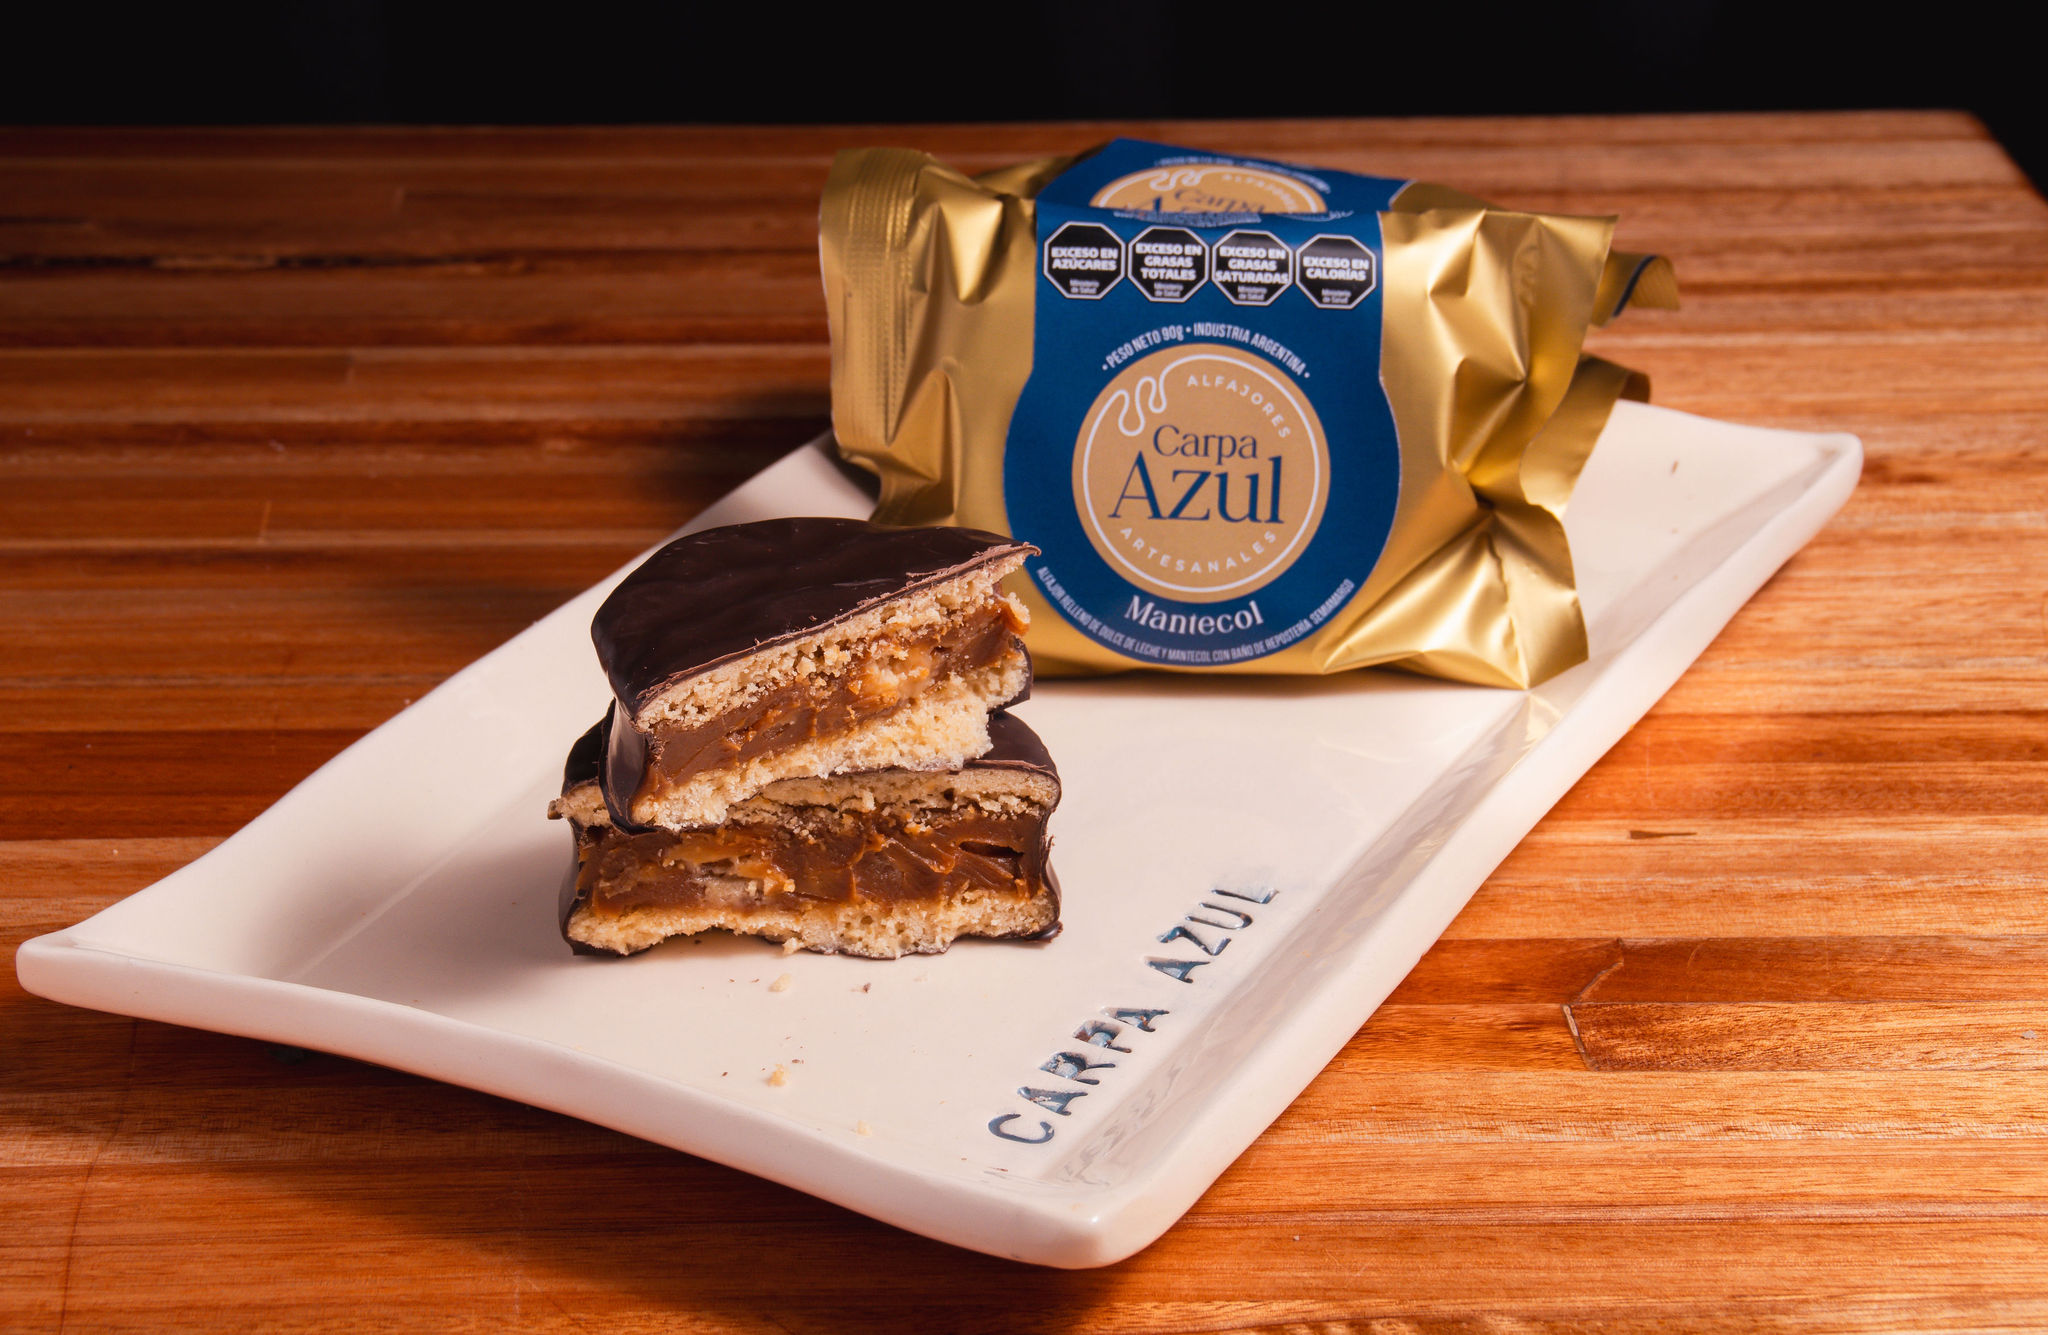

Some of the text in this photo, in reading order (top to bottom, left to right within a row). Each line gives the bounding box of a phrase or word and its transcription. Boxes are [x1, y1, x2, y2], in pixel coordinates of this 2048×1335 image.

[1051, 247, 1118, 259] EXCESO EN
[1135, 243, 1202, 256] EXCESO EN
[1219, 247, 1286, 259] EXCESO EN
[1052, 257, 1117, 270] AZÚCARES
[1144, 256, 1193, 267] GRASAS
[1228, 259, 1277, 271] GRASAS
[1303, 256, 1369, 270] EXCESO EN
[1140, 268, 1196, 280] TOTALES
[1215, 271, 1289, 284] SATURADAS
[1305, 268, 1366, 281] CALORÍAS
[1106, 322, 1306, 375] PESO NETO 90g INDUSTRIA ARGENTINA
[1187, 375, 1290, 438] ALFAJORES
[1153, 425, 1258, 465] Carpa
[1107, 450, 1285, 524] Azul
[1120, 527, 1276, 573] ARTESANALES
[1036, 566, 1066, 600] ALFAJOR
[1059, 594, 1093, 626] RELLENO
[1088, 618, 1102, 634] DE
[1099, 625, 1125, 646] DULCE
[1123, 637, 1137, 651] DE
[1135, 640, 1161, 659] LECHE
[1167, 648, 1211, 662] MANTECOL
[1212, 648, 1230, 662] CON
[1253, 641, 1266, 655] DE
[1124, 595, 1263, 636] Mantecol
[988, 887, 1280, 1144] CARPA AZUL
